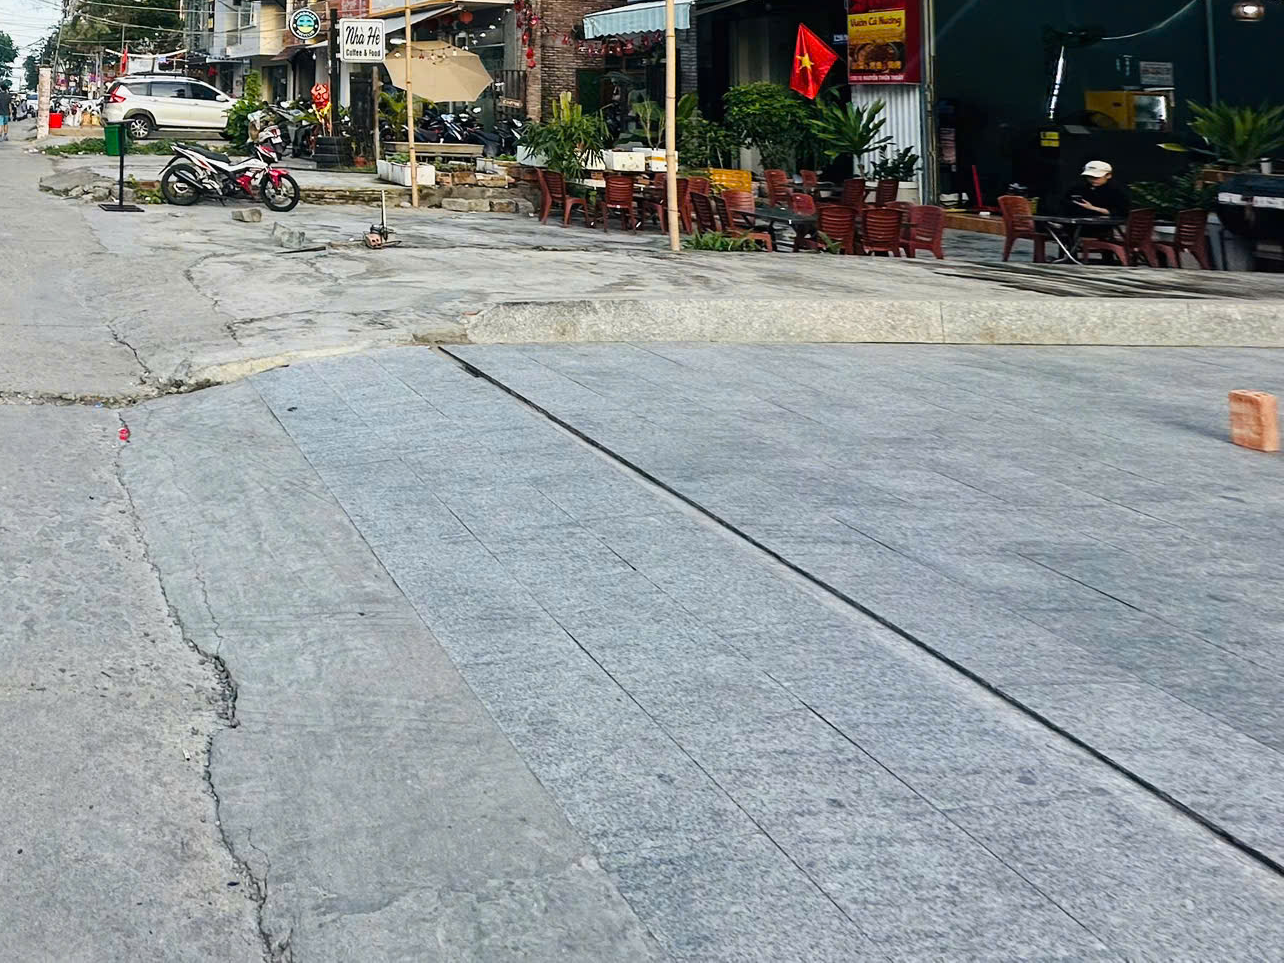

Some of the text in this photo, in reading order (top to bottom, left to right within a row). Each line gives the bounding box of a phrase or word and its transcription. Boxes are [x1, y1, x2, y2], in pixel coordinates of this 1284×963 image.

[345, 25, 381, 46] Nhà Hè
[346, 49, 363, 57] Coffee
